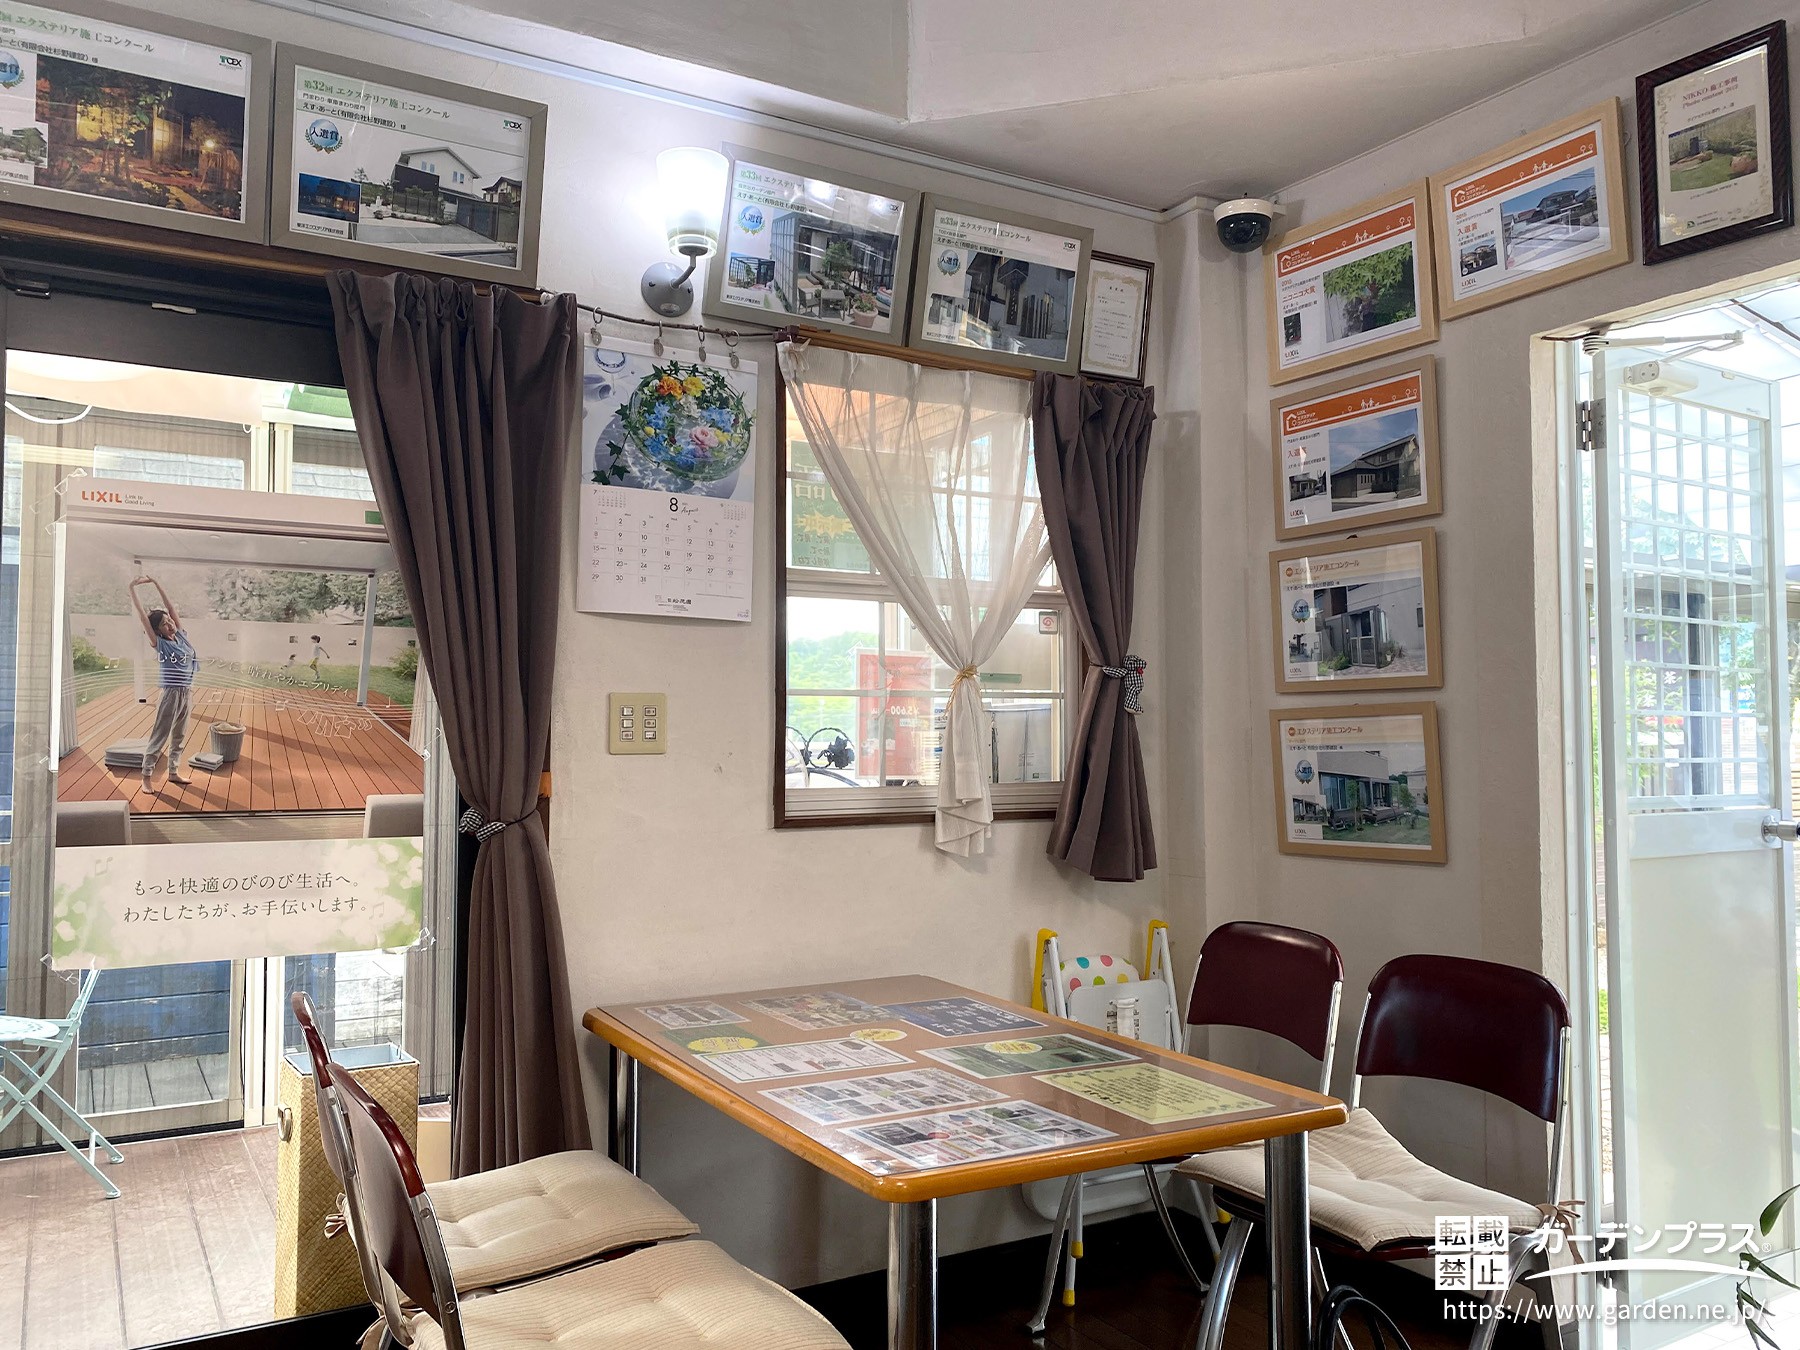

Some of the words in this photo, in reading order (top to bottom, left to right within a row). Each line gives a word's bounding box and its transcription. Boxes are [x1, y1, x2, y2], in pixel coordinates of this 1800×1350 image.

[304, 79, 333, 94] 第32回
[81, 490, 122, 504] LIXIL
[669, 497, 679, 512] 8
[134, 872, 359, 896] もっと快適のびのび生活へ。
[123, 896, 367, 923] わたしたちが、お手伝いします。
